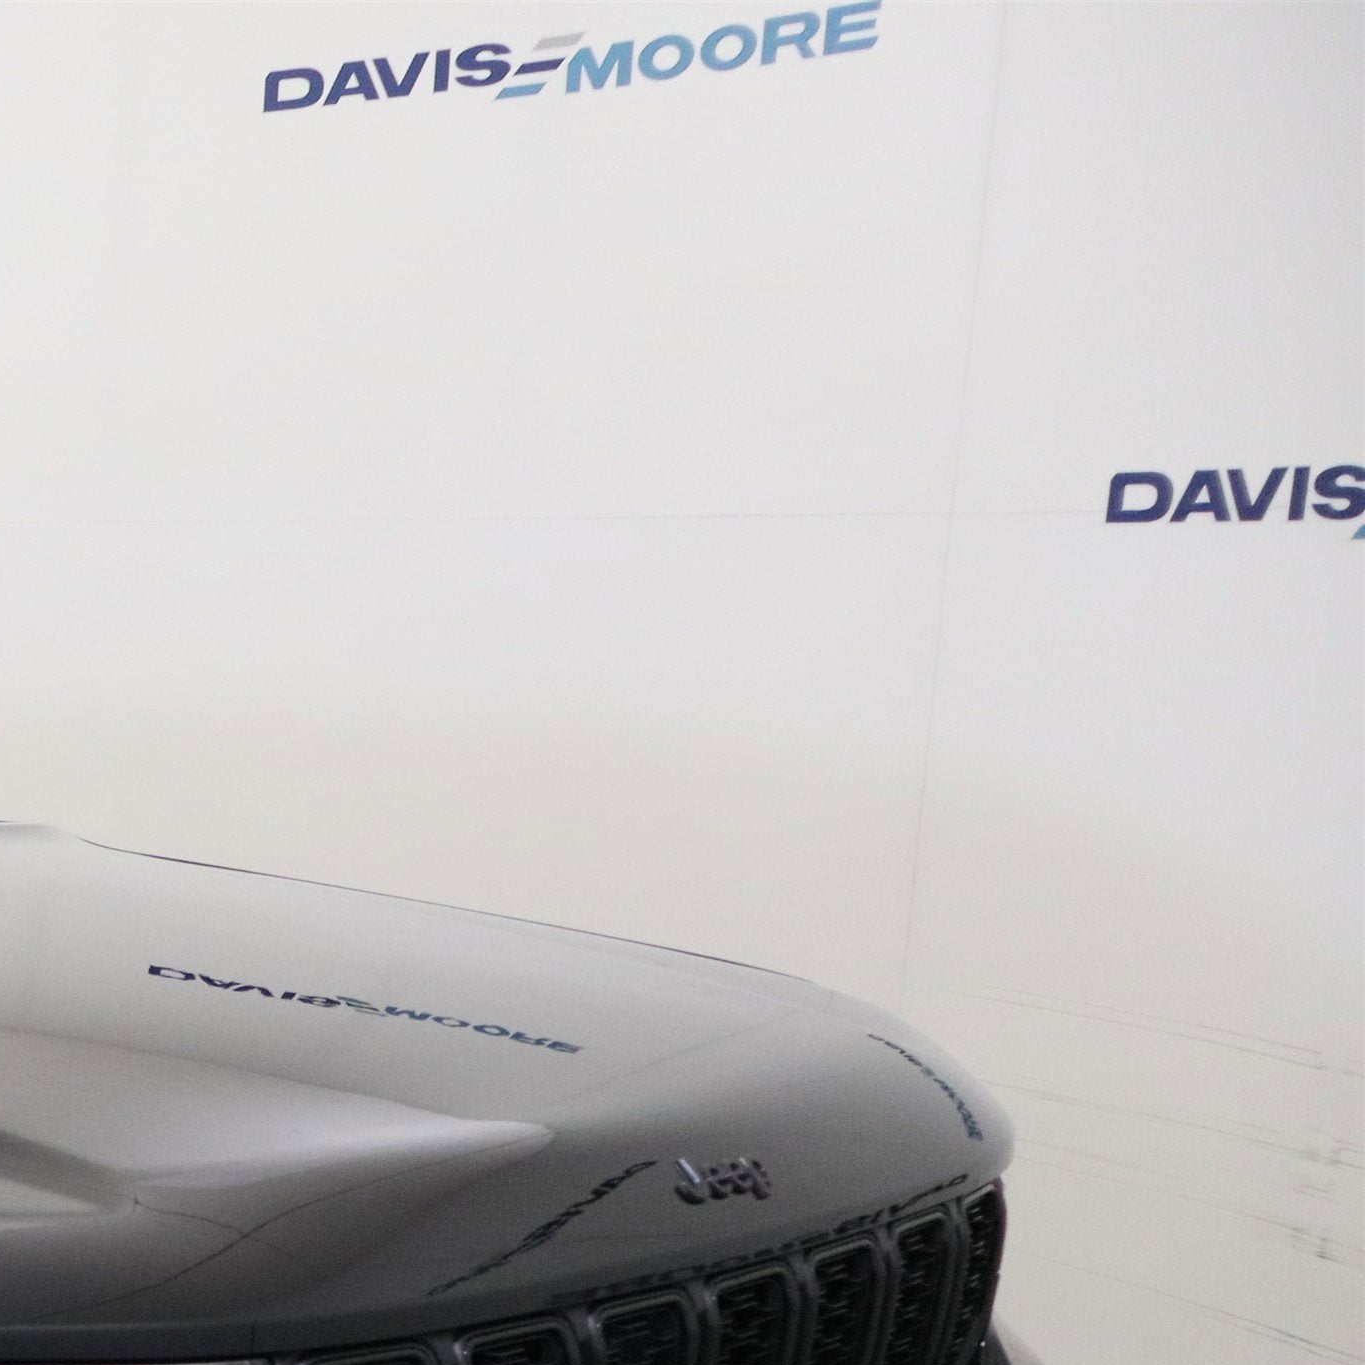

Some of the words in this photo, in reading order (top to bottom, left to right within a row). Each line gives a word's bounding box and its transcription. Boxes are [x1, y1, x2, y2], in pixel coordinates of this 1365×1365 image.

[263, 42, 512, 113] DAVIS
[564, 1, 880, 95] MOORE
[672, 1156, 771, 1206] Jeep
